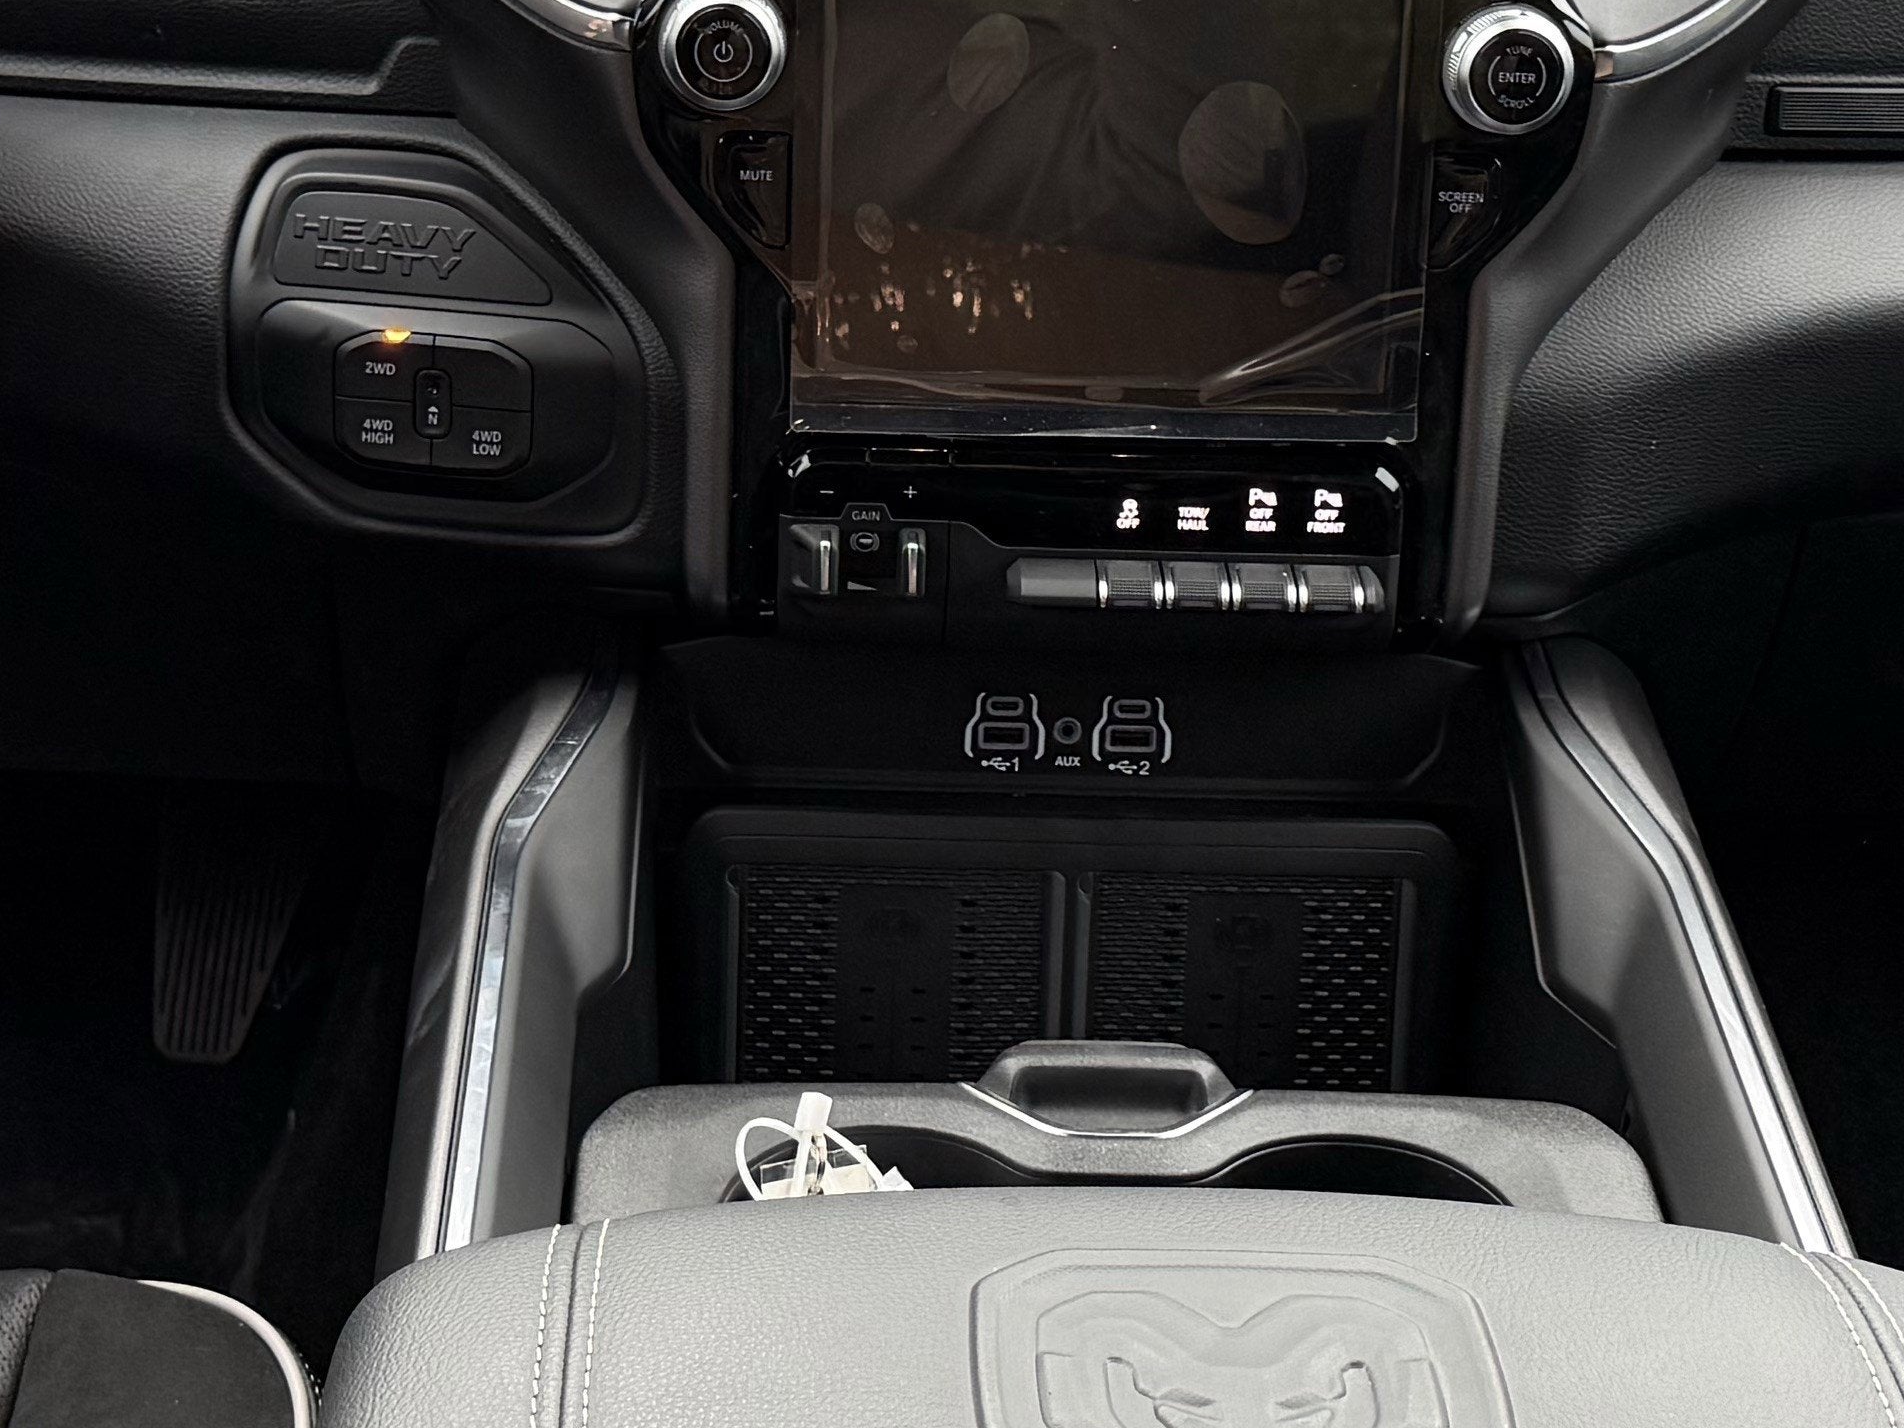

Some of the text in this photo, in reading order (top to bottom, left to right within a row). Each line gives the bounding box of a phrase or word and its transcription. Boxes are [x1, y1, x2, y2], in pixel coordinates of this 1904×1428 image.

[1506, 46, 1534, 57] TUNE
[1498, 72, 1535, 83] ENTER
[1497, 96, 1535, 110] SCROLL
[739, 170, 773, 181] MUTE
[1438, 191, 1484, 203] SCREEN
[1450, 203, 1472, 213] OFF
[293, 214, 476, 251] HEAVY
[315, 245, 462, 279] DUTY
[365, 362, 396, 376] 2WD
[362, 418, 393, 432] 4WD
[428, 412, 437, 426] N
[362, 432, 394, 445] HIGH
[472, 430, 502, 443] 4WD
[472, 444, 501, 457] LOW
[851, 510, 880, 521] GAIN
[1249, 508, 1274, 520] OFF
[1314, 509, 1340, 520] OFF
[1116, 518, 1140, 529] OFF
[1177, 520, 1209, 531] HAUL
[1013, 758, 1020, 771] 1
[1055, 756, 1080, 767] AUX
[1139, 761, 1150, 775] 2
